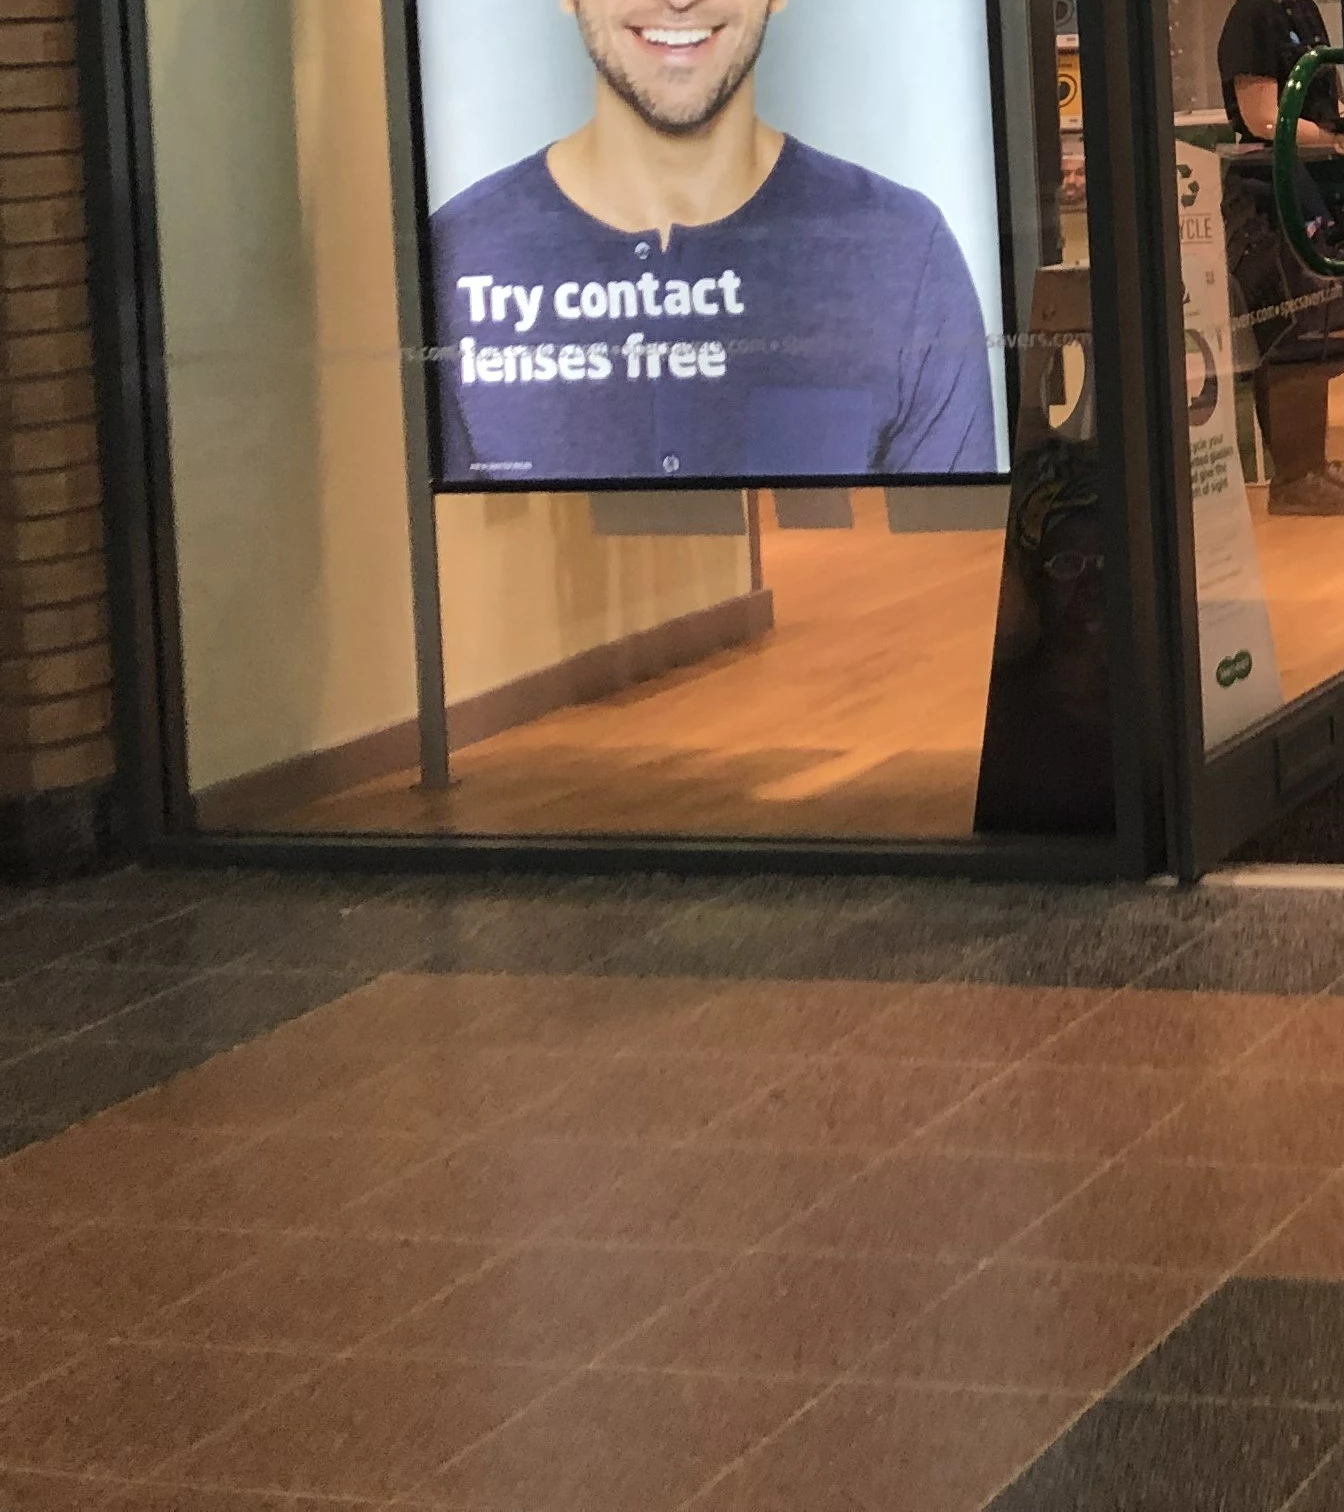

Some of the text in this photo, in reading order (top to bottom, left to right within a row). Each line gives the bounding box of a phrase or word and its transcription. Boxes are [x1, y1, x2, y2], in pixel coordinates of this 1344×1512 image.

[457, 269, 745, 333] Try contact
[459, 335, 614, 385] lenses
[622, 331, 728, 380] free
